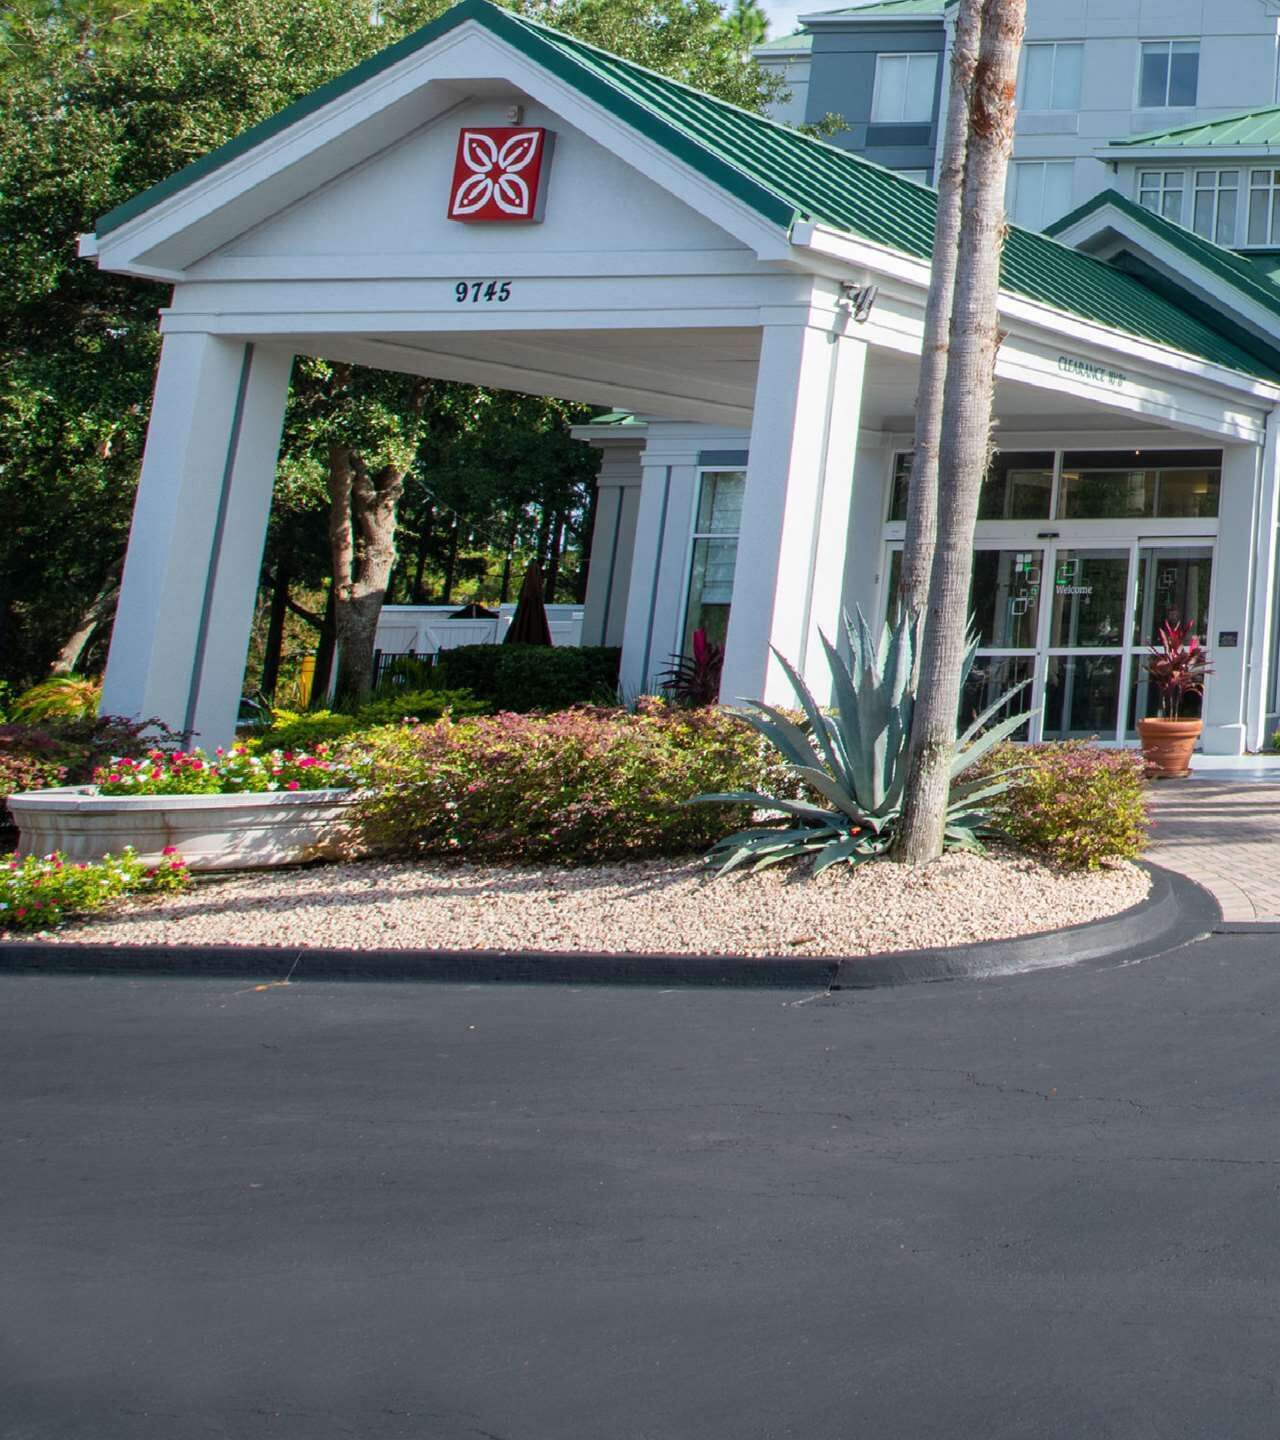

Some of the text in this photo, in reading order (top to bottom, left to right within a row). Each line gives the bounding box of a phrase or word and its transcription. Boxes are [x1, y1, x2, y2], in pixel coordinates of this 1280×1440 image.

[455, 281, 513, 303] 9745
[1058, 356, 1105, 382] CLEARANCE
[1056, 584, 1093, 595] Welcome
